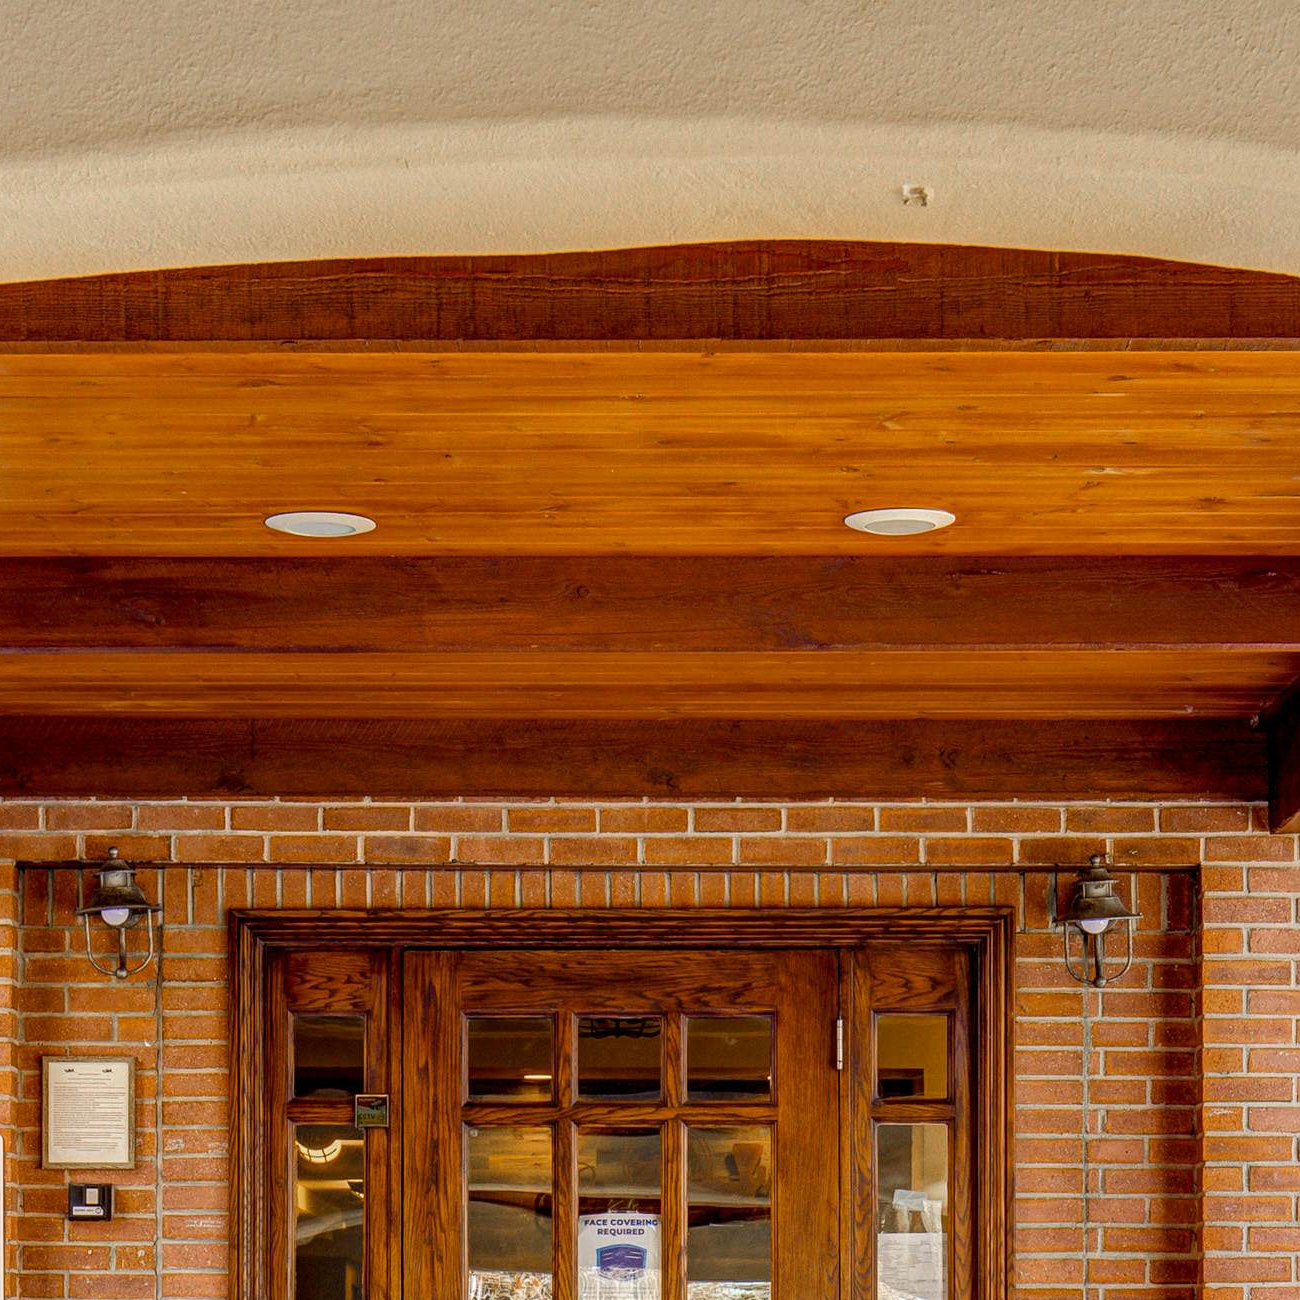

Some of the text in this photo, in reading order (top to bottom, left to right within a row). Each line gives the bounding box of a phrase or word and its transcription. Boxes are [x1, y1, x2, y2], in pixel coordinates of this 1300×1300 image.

[584, 1218, 659, 1226] FACE COVERING
[597, 1228, 645, 1236] REQUIRED
